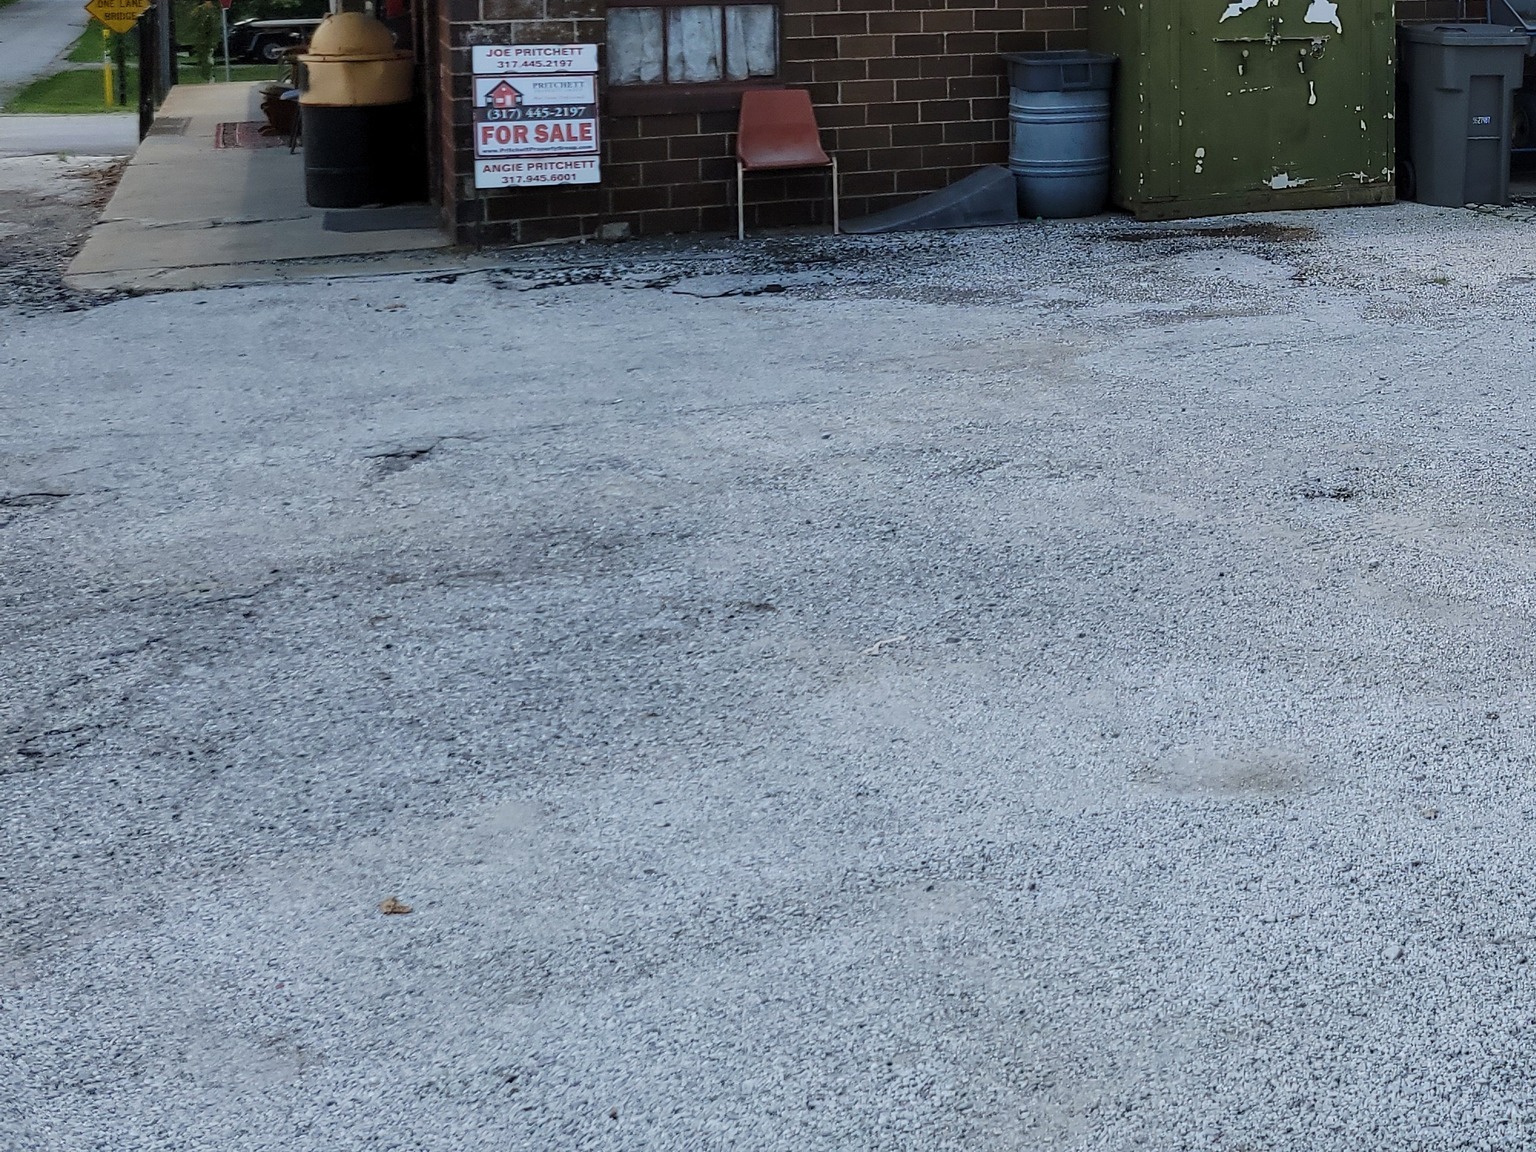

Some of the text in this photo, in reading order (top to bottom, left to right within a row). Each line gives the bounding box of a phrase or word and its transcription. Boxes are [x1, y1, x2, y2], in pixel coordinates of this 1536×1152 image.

[97, 0, 143, 8] ONE LANE
[104, 12, 138, 21] BRIDGE
[486, 48, 583, 57] JOE PRITCHETT
[497, 60, 573, 68] 317.445.2197
[532, 81, 585, 89] PRITCHETT
[487, 107, 586, 120] (317) 445-2197
[482, 123, 592, 145] FOR SALE
[483, 160, 595, 173] ANGIE PRITCHETT
[501, 173, 577, 184] 317.945.6001
